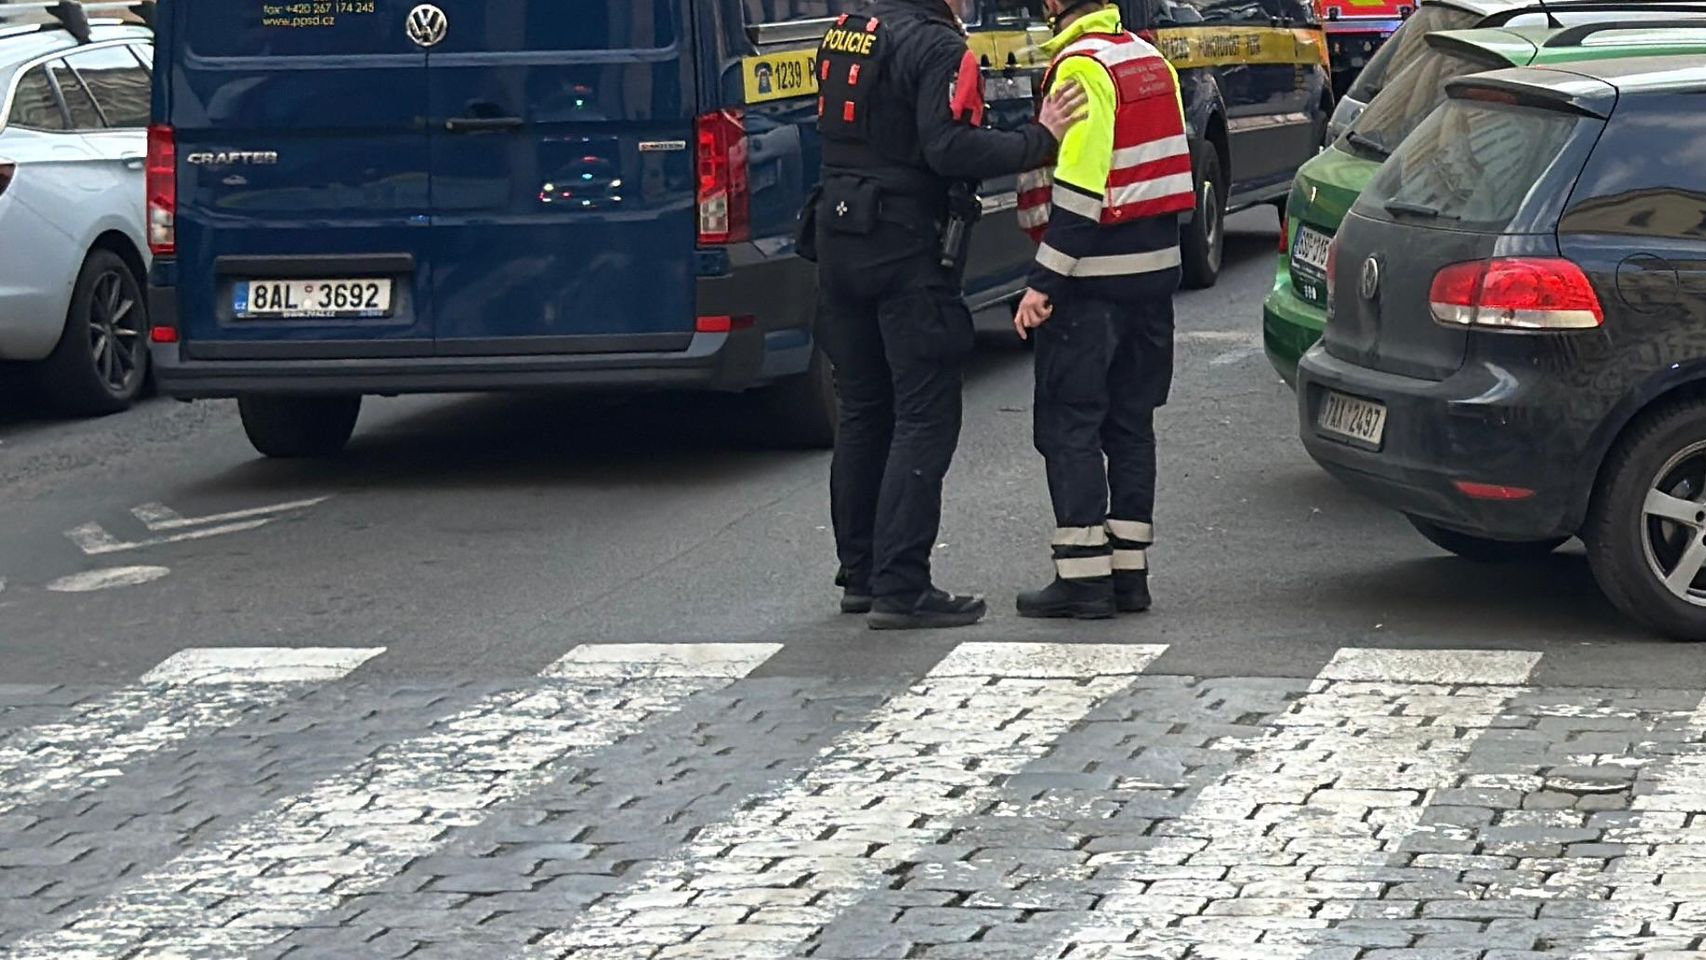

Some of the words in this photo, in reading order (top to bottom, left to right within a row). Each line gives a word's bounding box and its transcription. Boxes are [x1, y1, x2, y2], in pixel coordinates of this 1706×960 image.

[313, 3, 331, 14] 267
[822, 28, 876, 55] POLICIE
[775, 60, 802, 90] 1239
[187, 150, 278, 165] CRAFTER
[254, 284, 298, 309] 8AL
[318, 283, 379, 308] 3692
[1348, 403, 1381, 439] 2497
